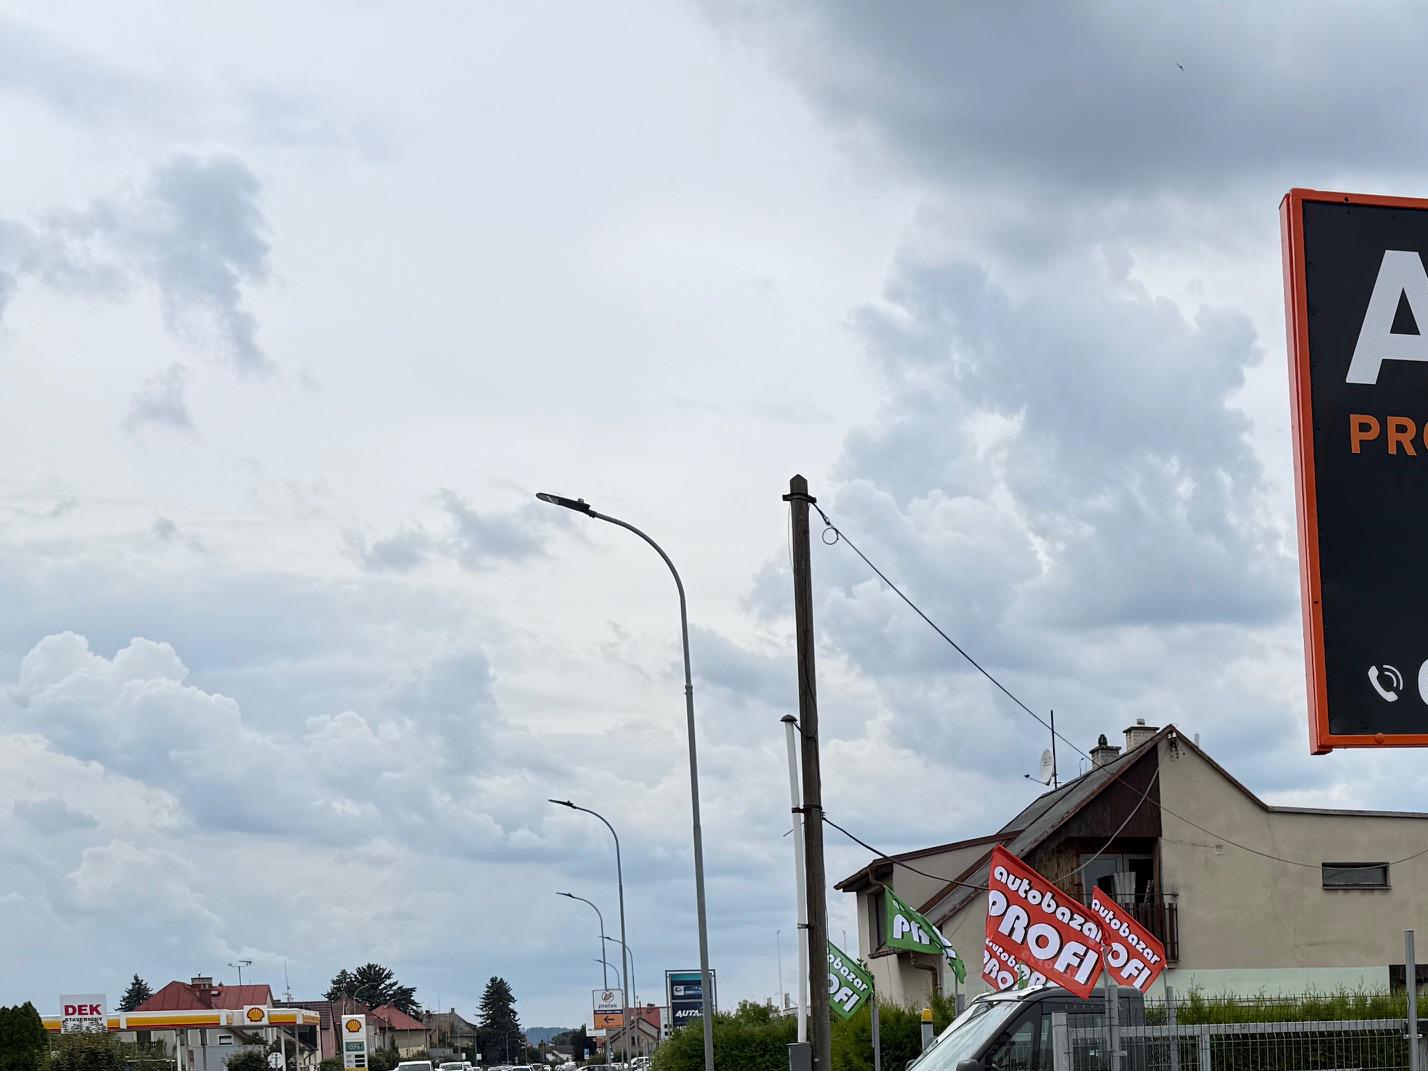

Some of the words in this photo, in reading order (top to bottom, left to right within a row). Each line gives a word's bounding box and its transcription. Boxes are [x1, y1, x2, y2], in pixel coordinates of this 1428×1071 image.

[989, 889, 1099, 985] PROFI
[1092, 898, 1161, 966] autobazar
[828, 953, 869, 992] obazar
[1107, 942, 1152, 990] OFI
[64, 1004, 102, 1016] DEK
[828, 973, 860, 1013] OFI
